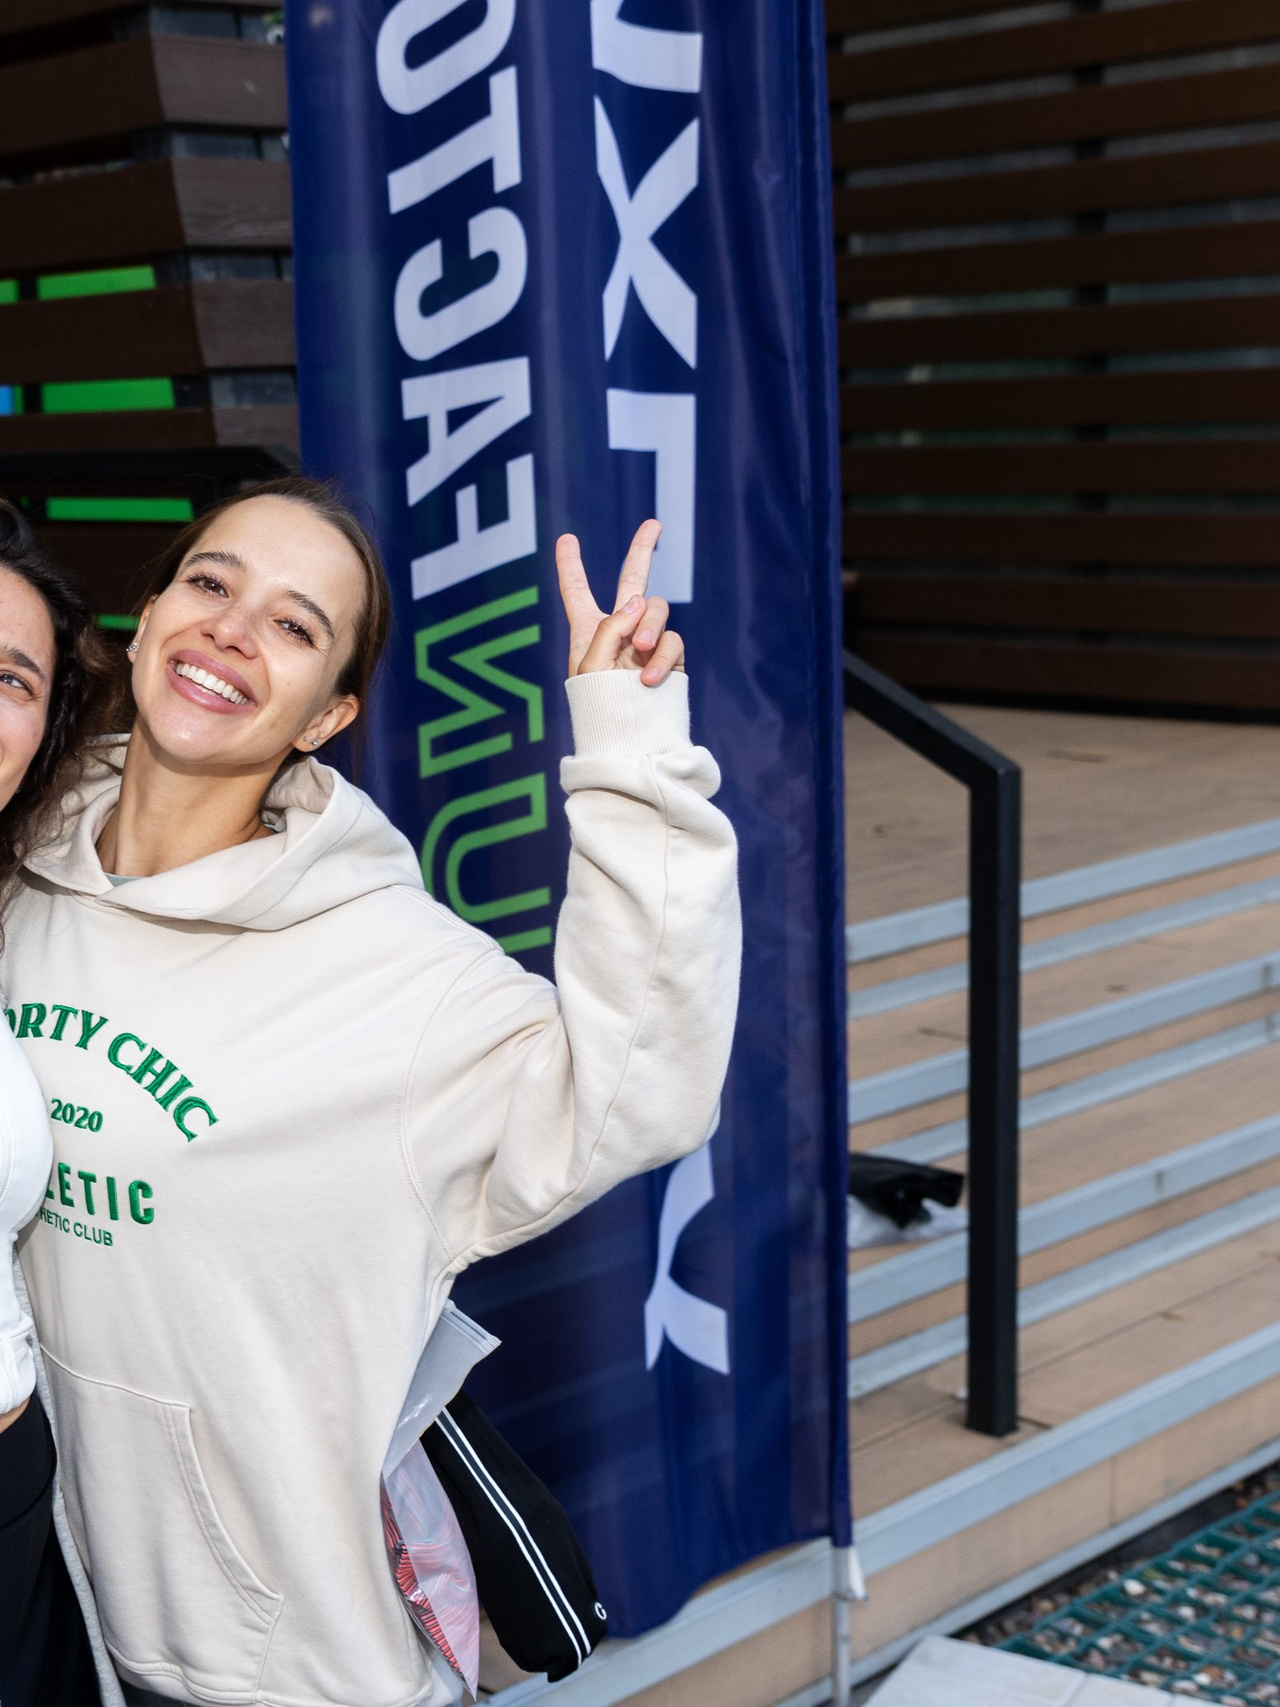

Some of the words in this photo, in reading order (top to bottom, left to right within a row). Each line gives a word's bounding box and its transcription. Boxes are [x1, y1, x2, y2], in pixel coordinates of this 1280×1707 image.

[107, 1032, 220, 1143] CHIC
[50, 1097, 104, 1133] 2020
[36, 1205, 71, 1234] HETIC
[73, 1221, 114, 1247] CLUB
